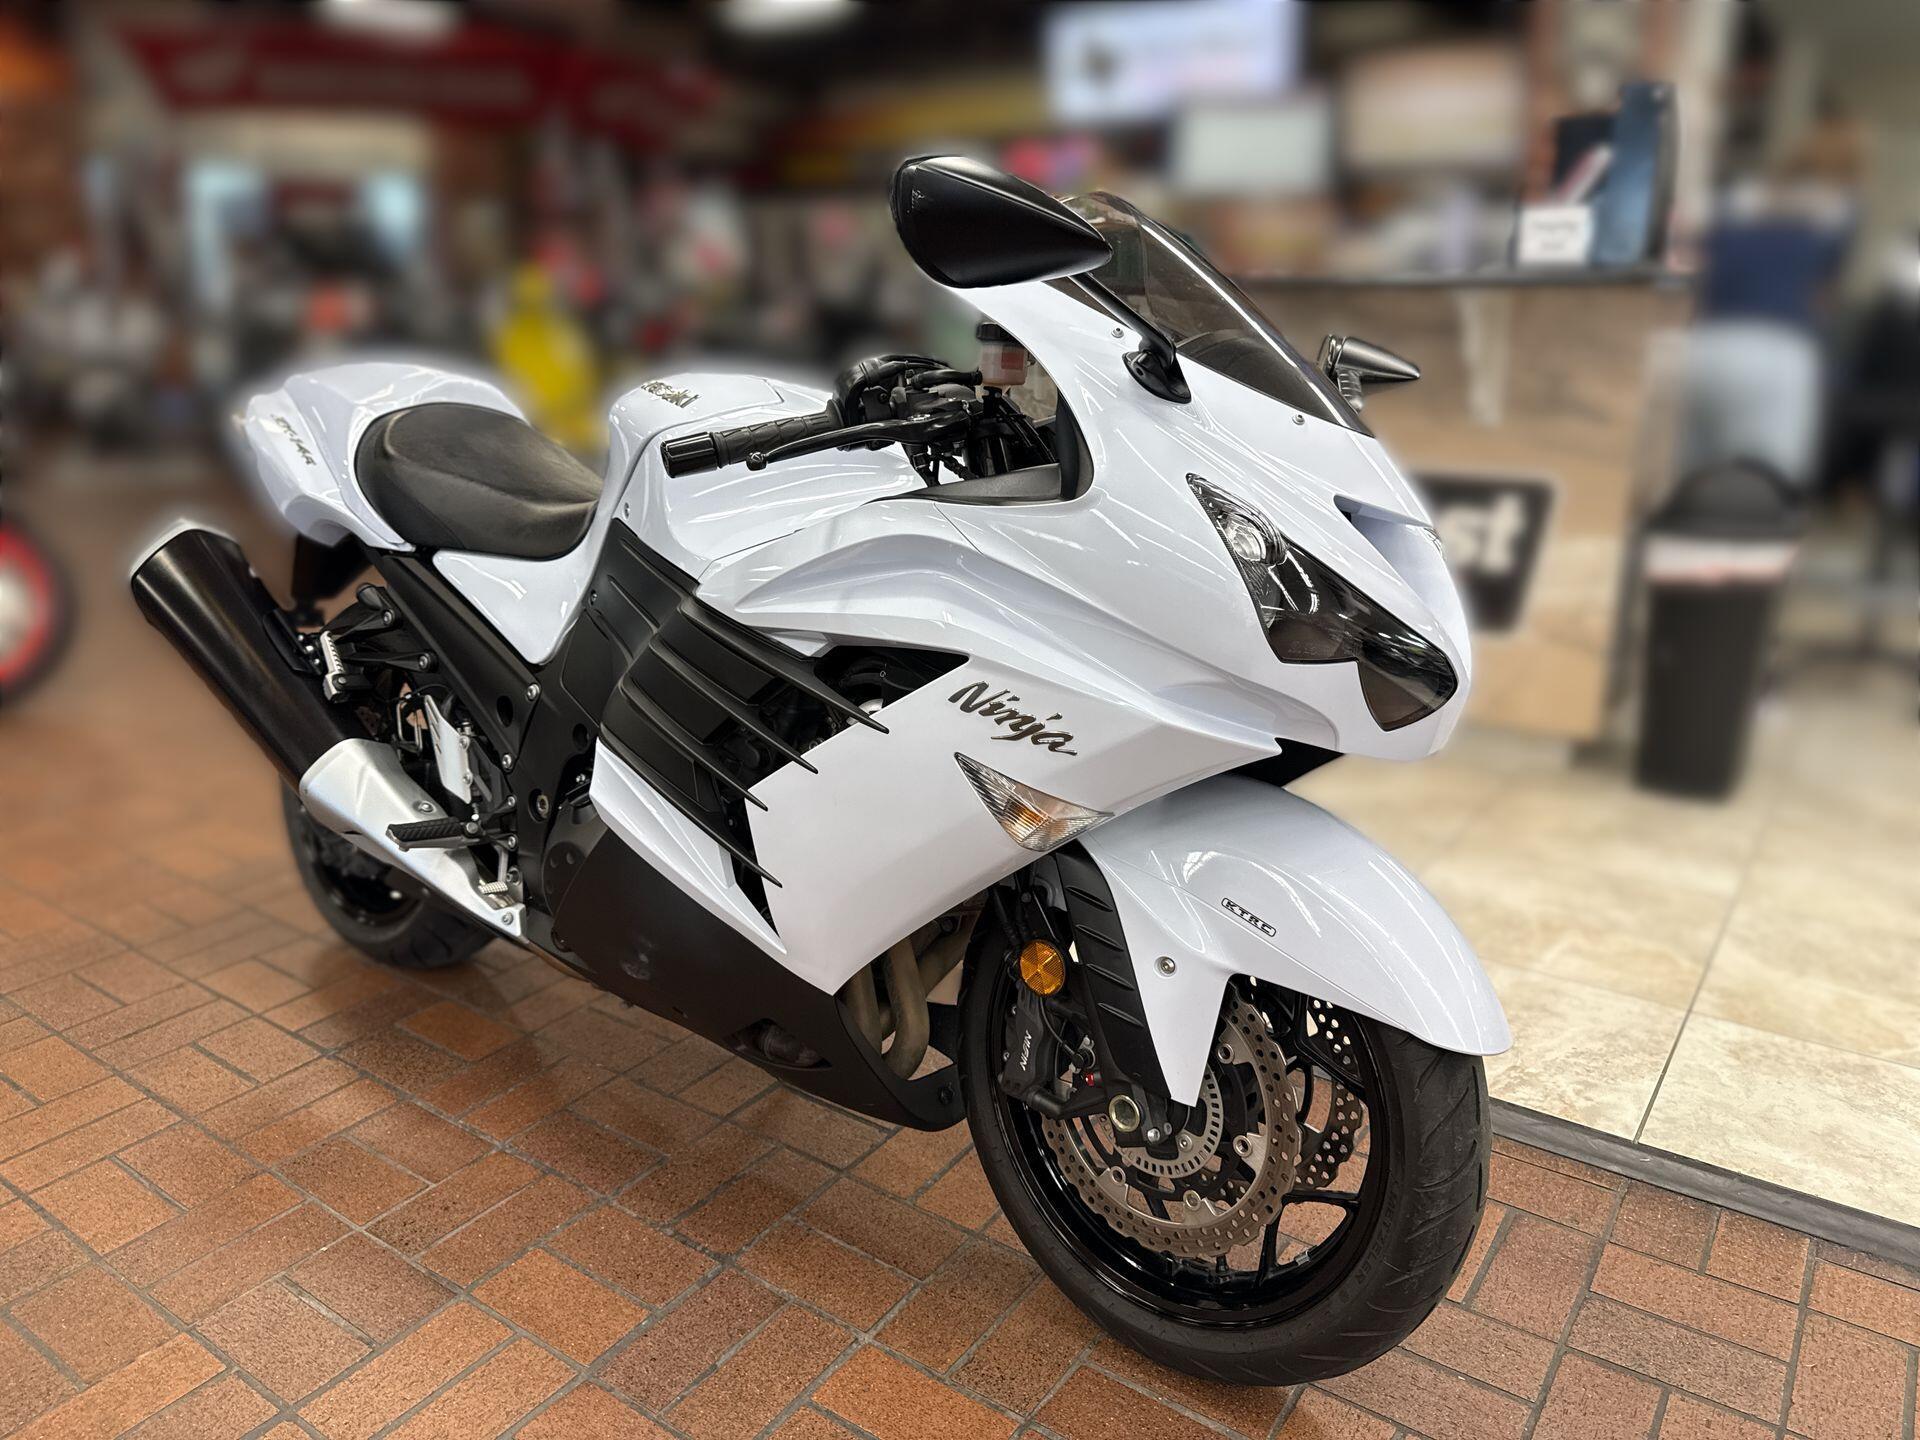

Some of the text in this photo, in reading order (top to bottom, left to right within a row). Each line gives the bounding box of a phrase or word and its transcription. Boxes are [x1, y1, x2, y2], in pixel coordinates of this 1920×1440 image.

[1437, 494, 1521, 571] st
[948, 680, 1077, 756] Ninja
[1225, 900, 1273, 935] KTRC
